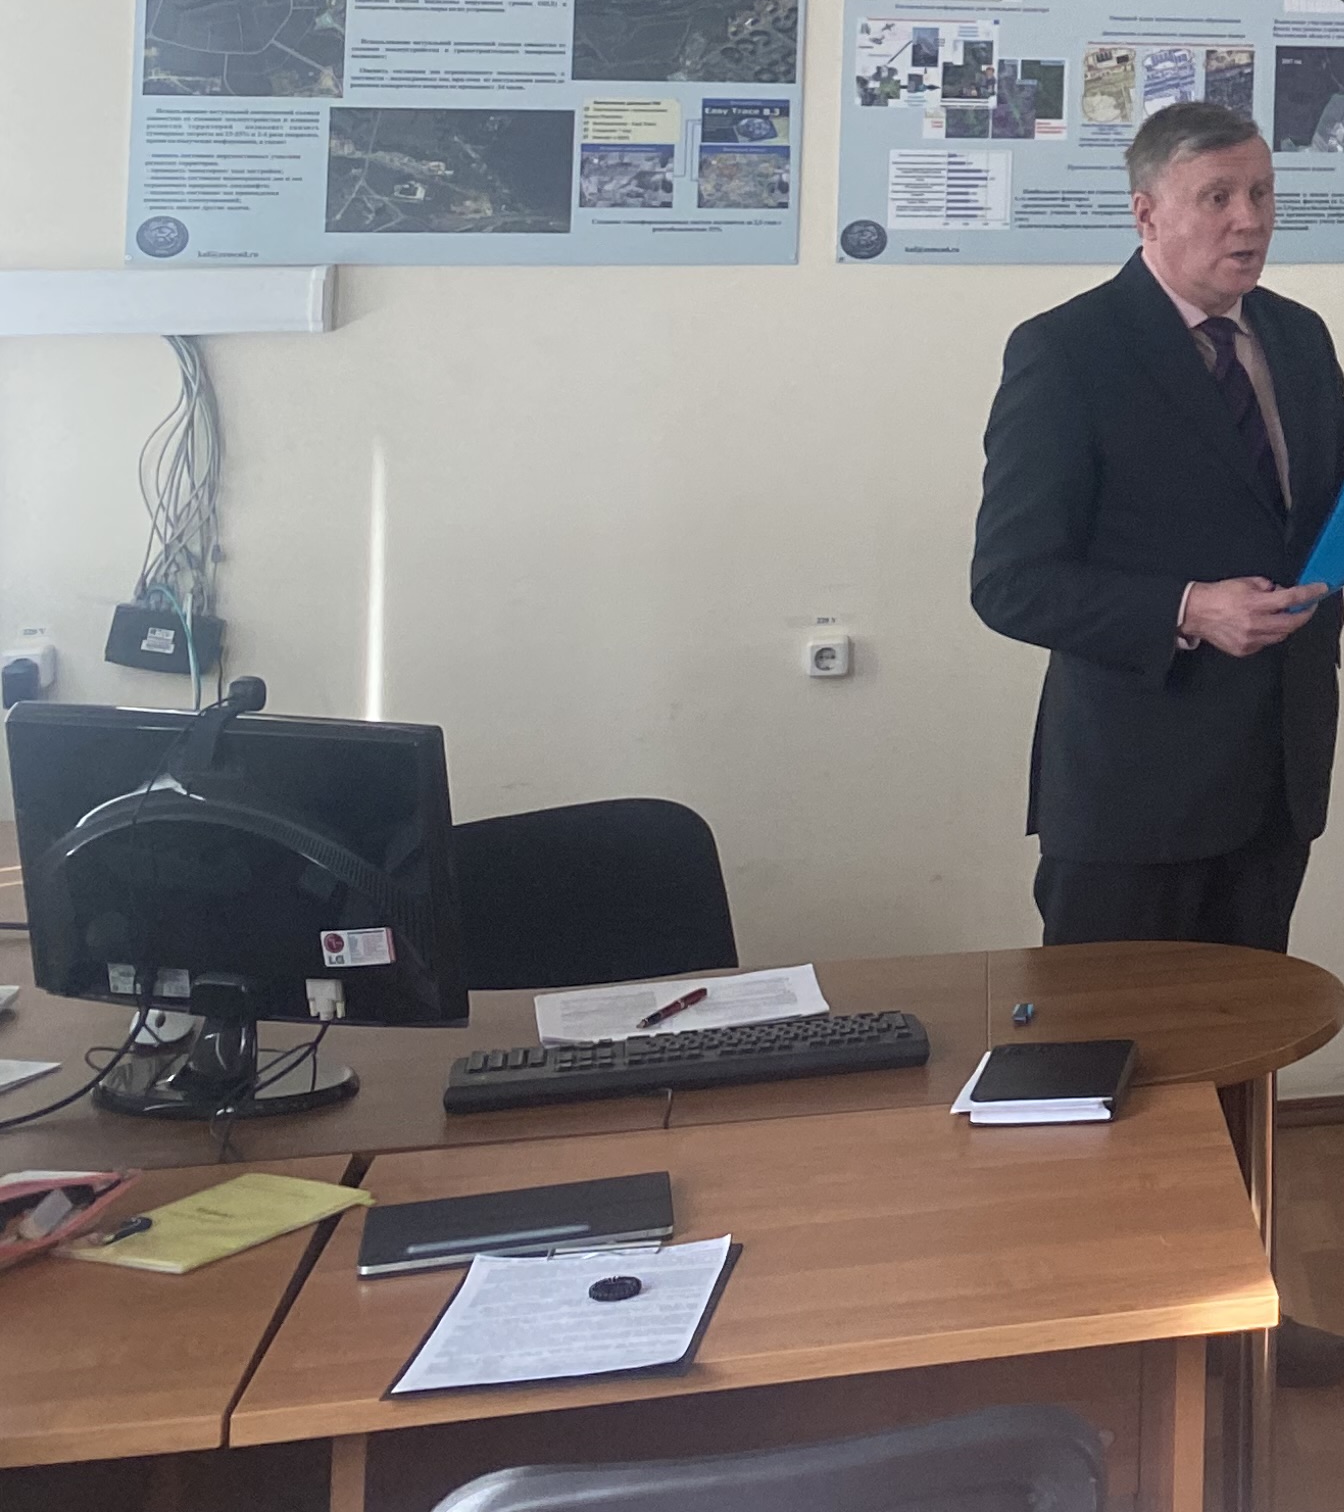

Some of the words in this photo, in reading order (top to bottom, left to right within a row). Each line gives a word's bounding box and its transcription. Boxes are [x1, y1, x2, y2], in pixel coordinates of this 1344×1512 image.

[704, 107, 728, 116] Easy
[732, 107, 760, 115] Trace
[328, 955, 345, 965] LG
